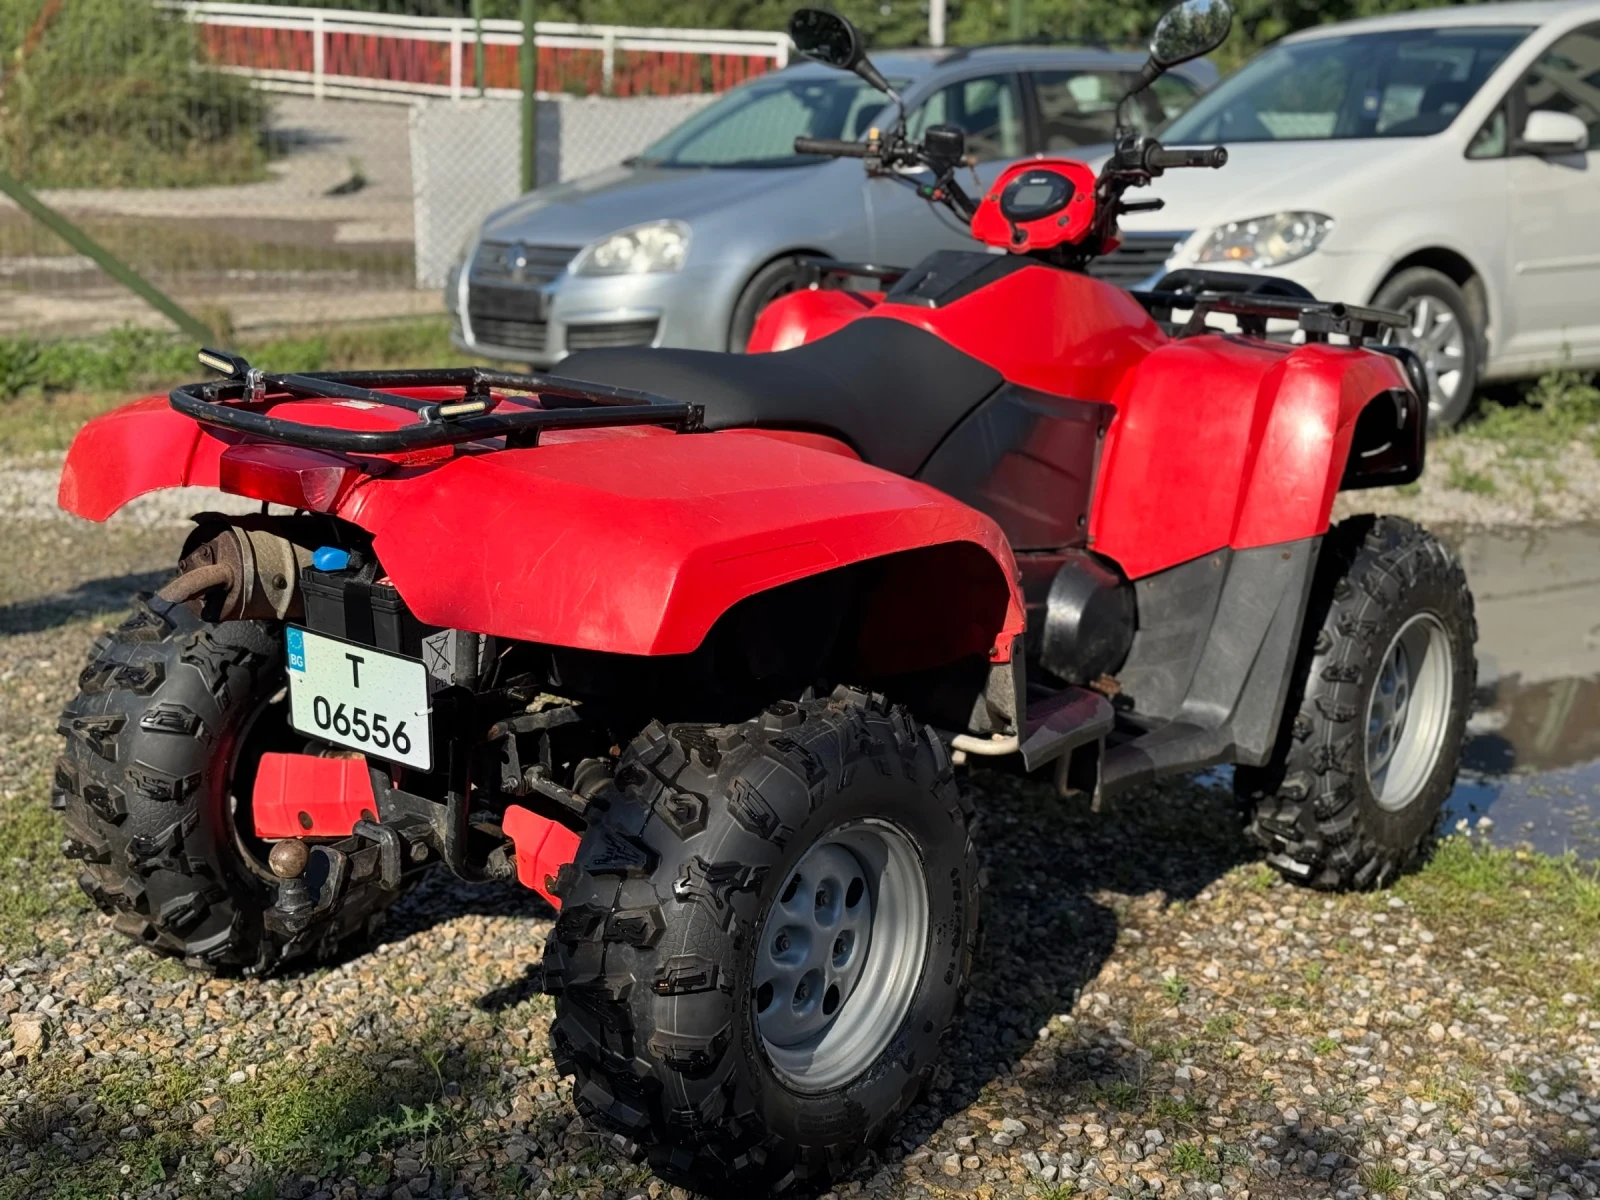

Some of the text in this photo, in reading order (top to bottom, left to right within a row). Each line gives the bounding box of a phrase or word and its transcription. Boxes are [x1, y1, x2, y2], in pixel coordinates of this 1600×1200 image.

[291, 655, 304, 667] BG
[345, 652, 365, 688] T
[313, 695, 411, 755] 06556
